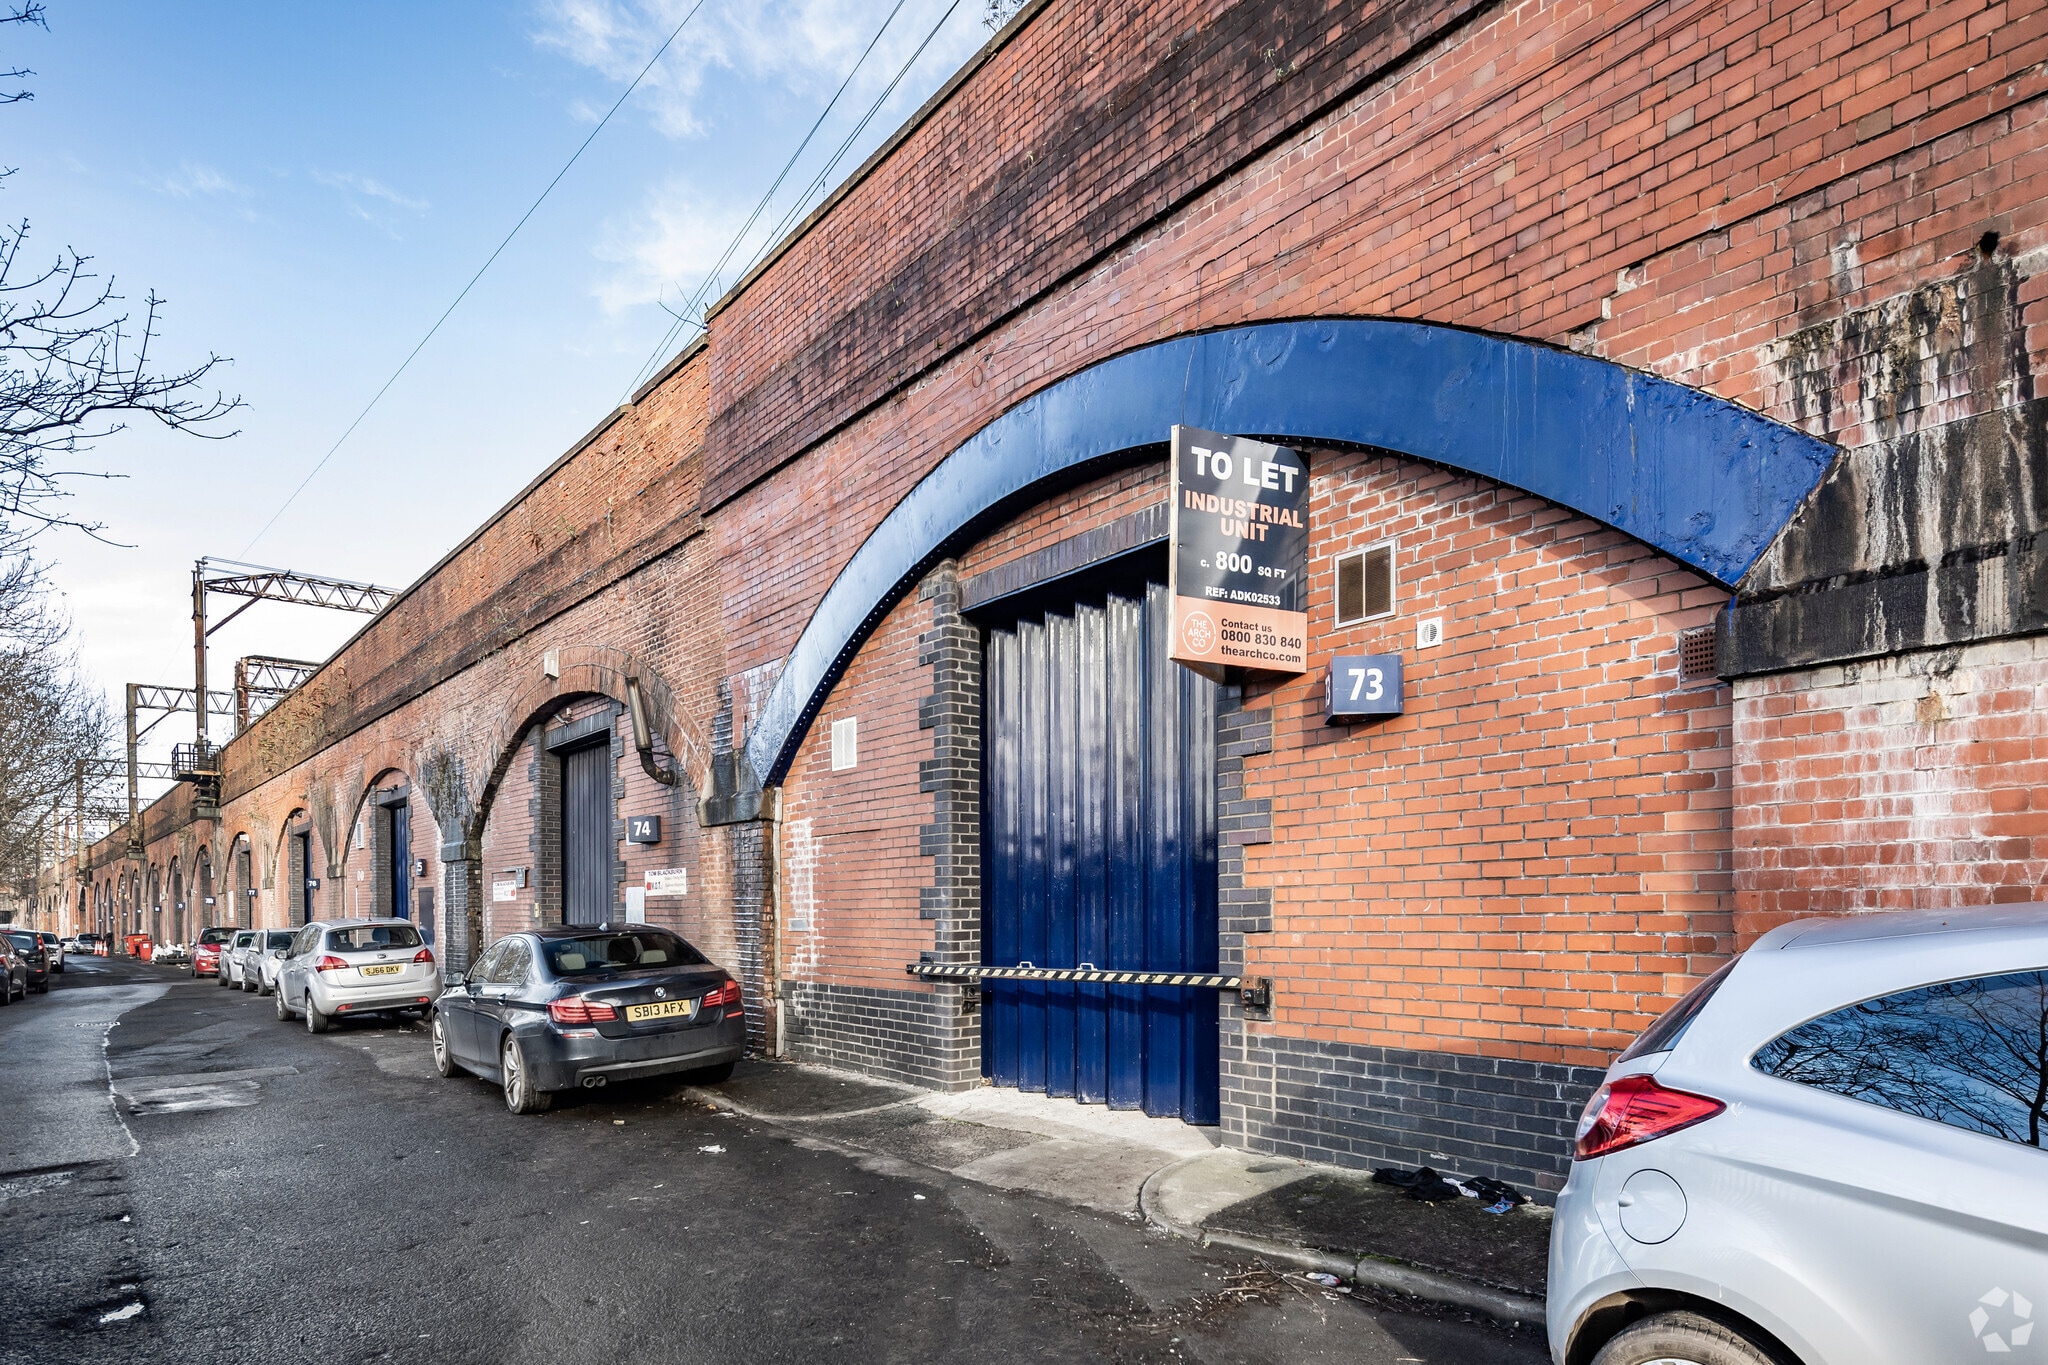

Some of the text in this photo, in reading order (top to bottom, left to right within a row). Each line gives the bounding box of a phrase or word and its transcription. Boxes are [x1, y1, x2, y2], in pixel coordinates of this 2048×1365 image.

[1191, 446, 1299, 493] TO LET
[1185, 490, 1304, 528] INDUSTRIAL
[1220, 517, 1269, 541] UNIT
[1200, 551, 1286, 579] c. 800 SQ FT
[1205, 586, 1281, 605] REF: ADK02533
[1191, 619, 1208, 629] THE
[1221, 618, 1273, 633] Contact us
[1187, 628, 1211, 639] ARCH
[1192, 638, 1206, 647] CO
[1221, 629, 1302, 649] 0800 830 840
[1221, 645, 1301, 663] thearchco.com
[1348, 668, 1384, 701] 73
[633, 821, 651, 836] 74
[365, 967, 385, 975] SJ66
[634, 1002, 685, 1018] SB13 AFX
